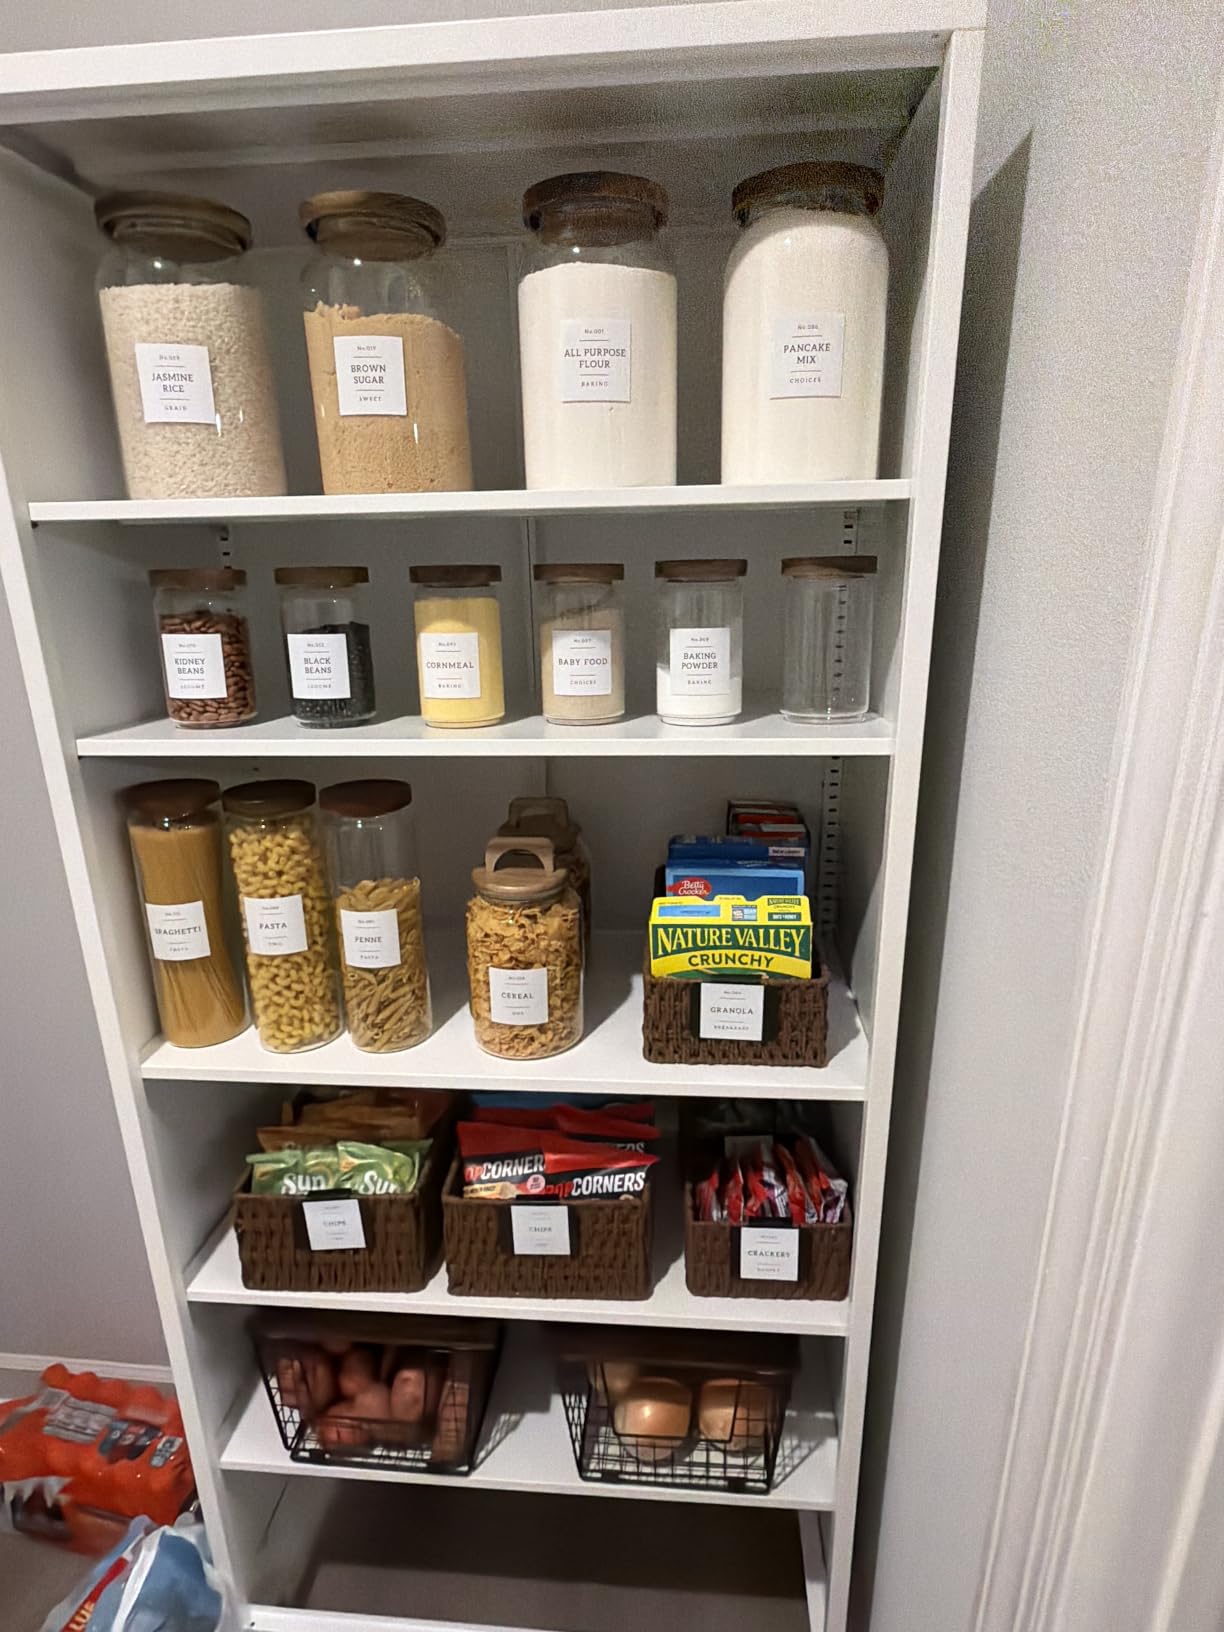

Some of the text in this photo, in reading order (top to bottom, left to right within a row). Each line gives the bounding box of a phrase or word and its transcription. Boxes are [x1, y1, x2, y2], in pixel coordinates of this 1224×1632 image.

[564, 347, 626, 358] ALL PURPOSE
[783, 343, 831, 354] PANCAKE
[579, 360, 610, 369] FLOUR
[796, 355, 816, 365] MIX
[350, 364, 386, 373] BROWN
[151, 372, 194, 383] JASMINE
[353, 375, 385, 385] SUGAR
[162, 384, 185, 393] RICE
[683, 652, 717, 660] BAKING
[174, 657, 206, 666] KIDNEY
[303, 657, 332, 665] BLACK
[426, 661, 475, 669] CORNMEAL
[558, 657, 608, 666] BABY FOOD
[681, 662, 718, 670] POWDER
[177, 667, 205, 675] BEANS
[682, 880, 705, 889] Betty
[678, 887, 709, 896] Crocker
[259, 922, 288, 930] PASTA
[656, 928, 806, 957] NATURE VALLEY
[688, 953, 775, 968] CRUNCHY
[501, 992, 535, 1000] CEREAL
[710, 1006, 754, 1015] GRANOLA
[281, 1172, 326, 1195] Sun
[747, 1250, 790, 1258] CRACKERS
